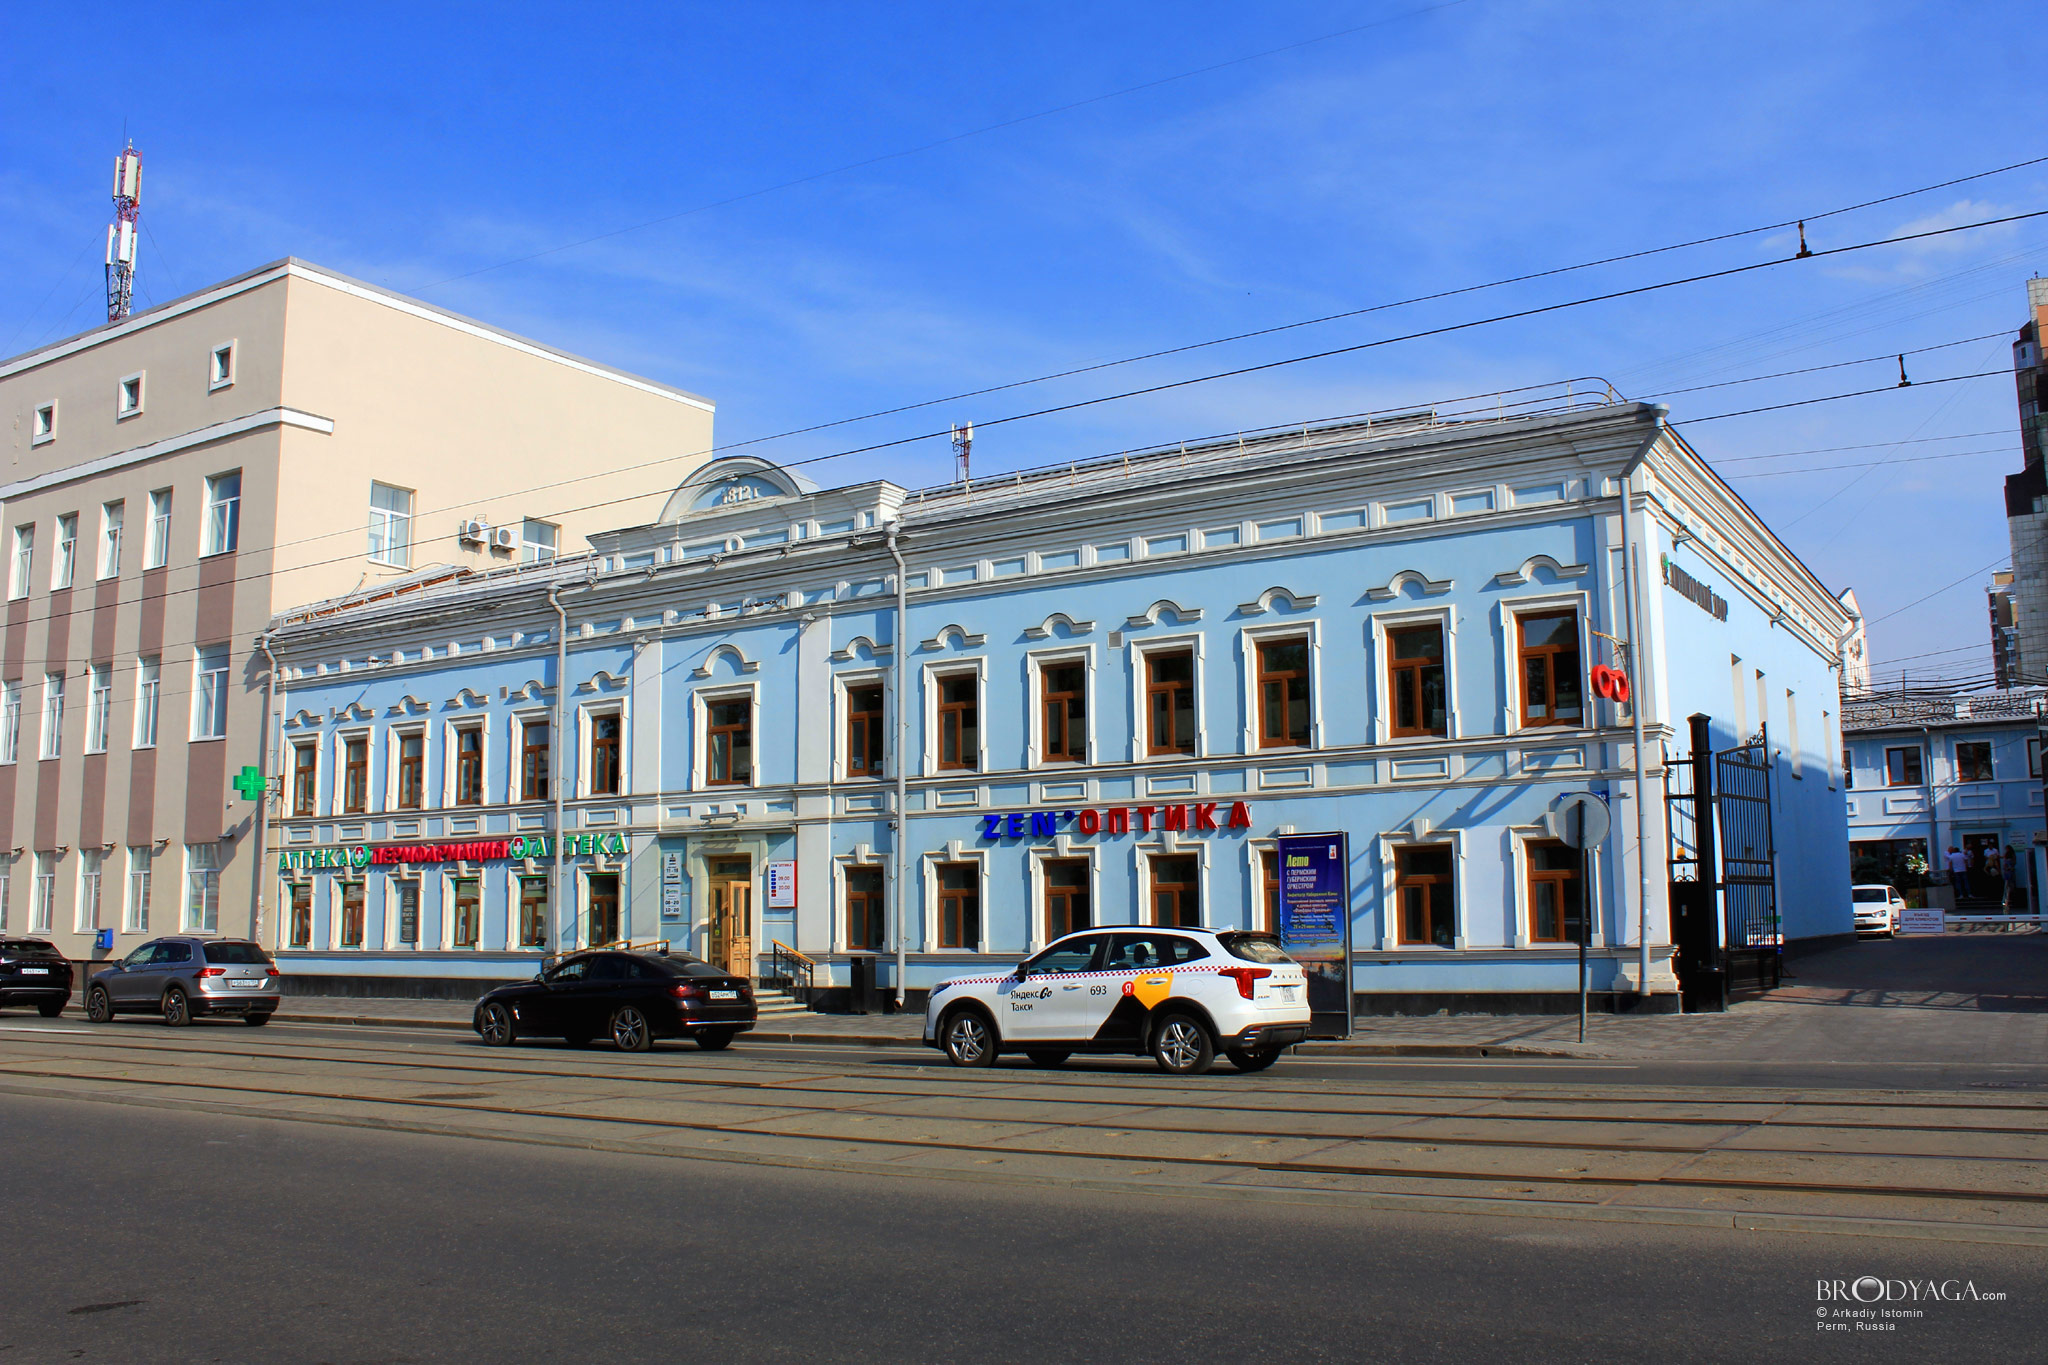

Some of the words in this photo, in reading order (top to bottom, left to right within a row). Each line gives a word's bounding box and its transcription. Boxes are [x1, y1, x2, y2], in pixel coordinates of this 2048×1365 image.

[983, 811, 1056, 839] ZEN
[1079, 802, 1252, 834] ОПТИКА
[280, 848, 352, 869] АПТЕКА
[372, 841, 508, 863] ПЕРМФАРМАЦИЯ
[1010, 990, 1039, 1000] Яндекс
[1090, 986, 1107, 996] 693
[1011, 1002, 1033, 1011] Такси
